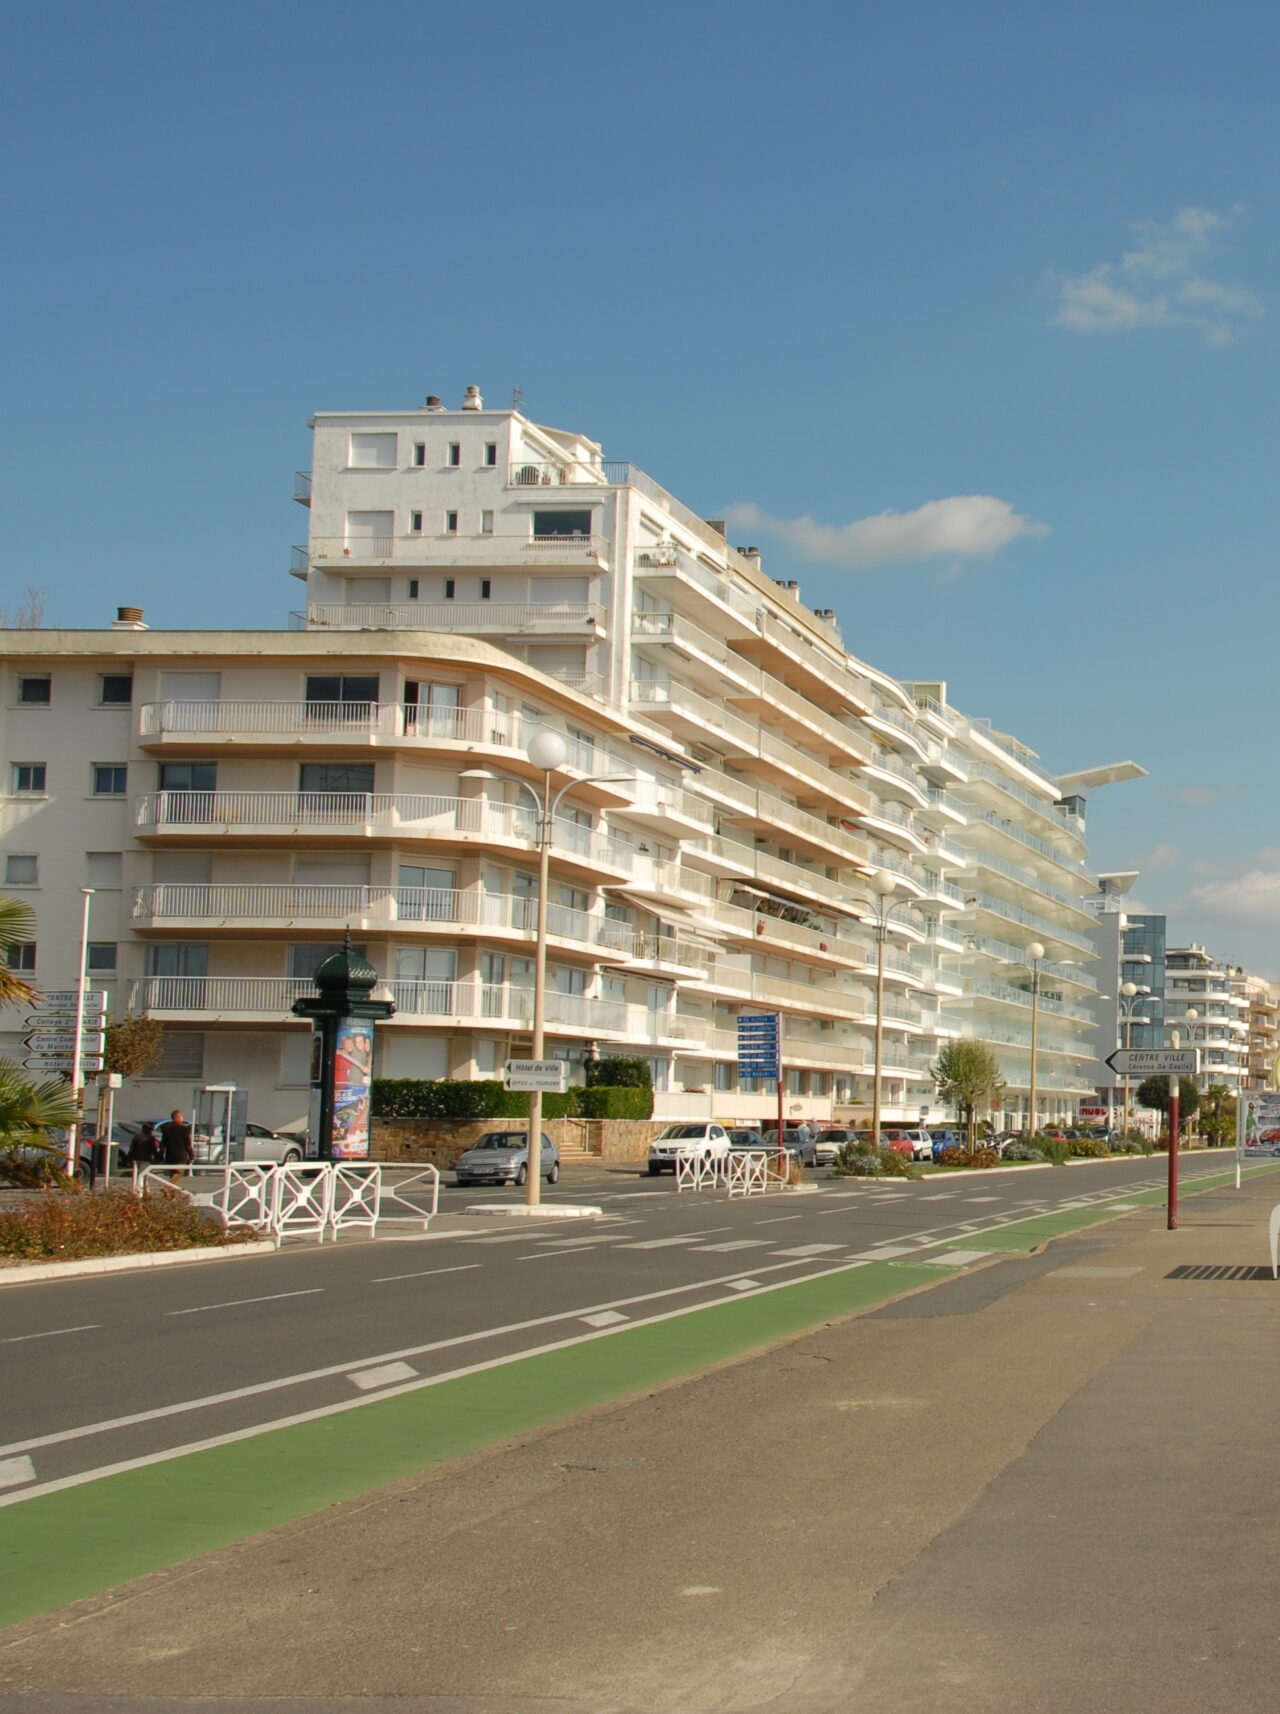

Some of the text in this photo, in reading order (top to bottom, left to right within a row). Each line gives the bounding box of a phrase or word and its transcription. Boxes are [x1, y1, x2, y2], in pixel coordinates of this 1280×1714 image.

[1128, 1053, 1186, 1062] CENTRE VILLE
[515, 1063, 559, 1072] Hôtel de Ville
